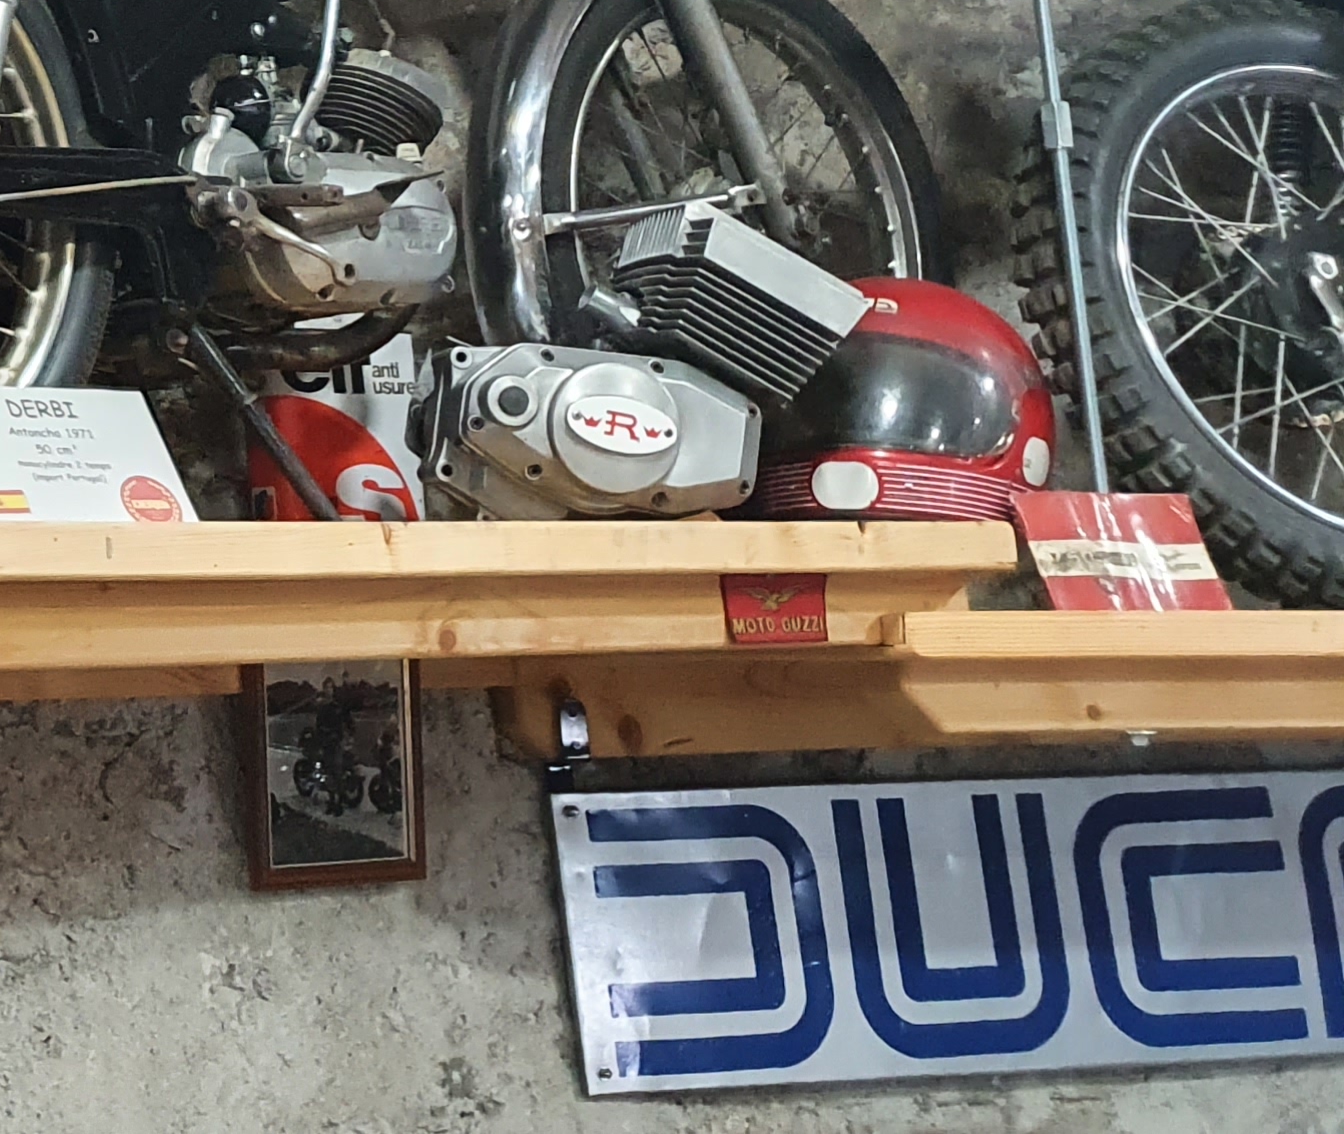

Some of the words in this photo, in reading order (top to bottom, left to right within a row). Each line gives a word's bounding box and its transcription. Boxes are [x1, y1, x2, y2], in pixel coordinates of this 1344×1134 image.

[372, 362, 400, 379] anti
[373, 381, 416, 394] usure
[4, 398, 79, 419] DERBI
[35, 444, 52, 454] 50
[732, 617, 775, 634] MOTO
[781, 616, 825, 633] GUZZI
[587, 785, 1344, 1078] DUC
